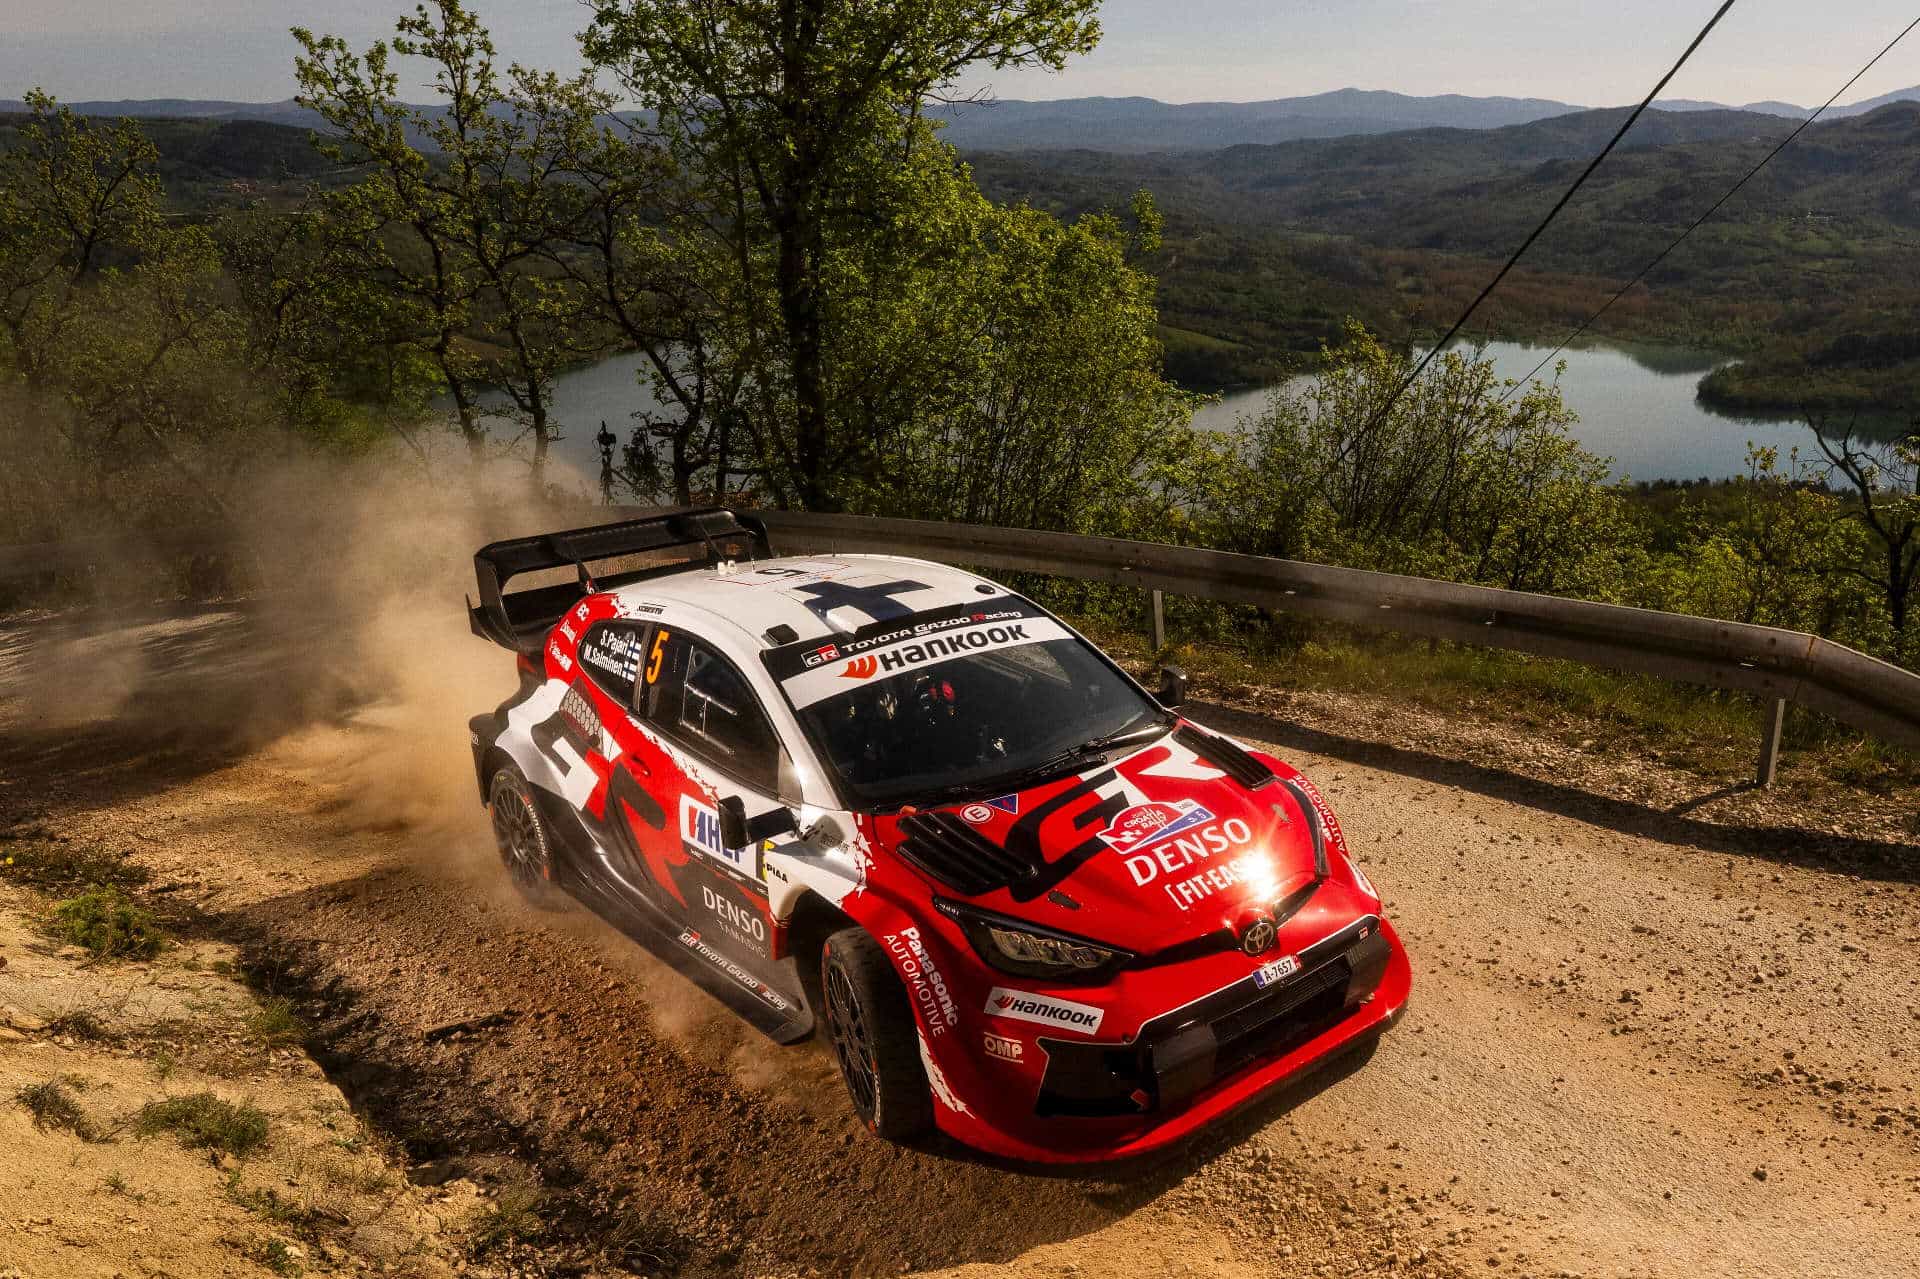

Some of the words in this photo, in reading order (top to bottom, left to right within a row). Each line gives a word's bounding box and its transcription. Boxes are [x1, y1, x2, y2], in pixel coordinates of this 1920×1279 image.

[646, 630, 670, 684] 5
[805, 647, 841, 668] GR
[841, 629, 912, 652] TOYOTA
[914, 616, 970, 637] GAZOO
[971, 610, 1022, 623] Racing
[1293, 774, 1345, 852] AUTOMOTIVE
[766, 863, 789, 884] PIAA
[1124, 818, 1251, 887] DENSO
[703, 885, 764, 941] DENSO
[695, 942, 726, 968] TOYOTA
[726, 964, 758, 989] GAZOO
[883, 934, 945, 1037] AUTOMOTIVE
[900, 926, 958, 1027] Panasonic
[1263, 958, 1293, 982] A-7657
[983, 1036, 1024, 1058] OMP
